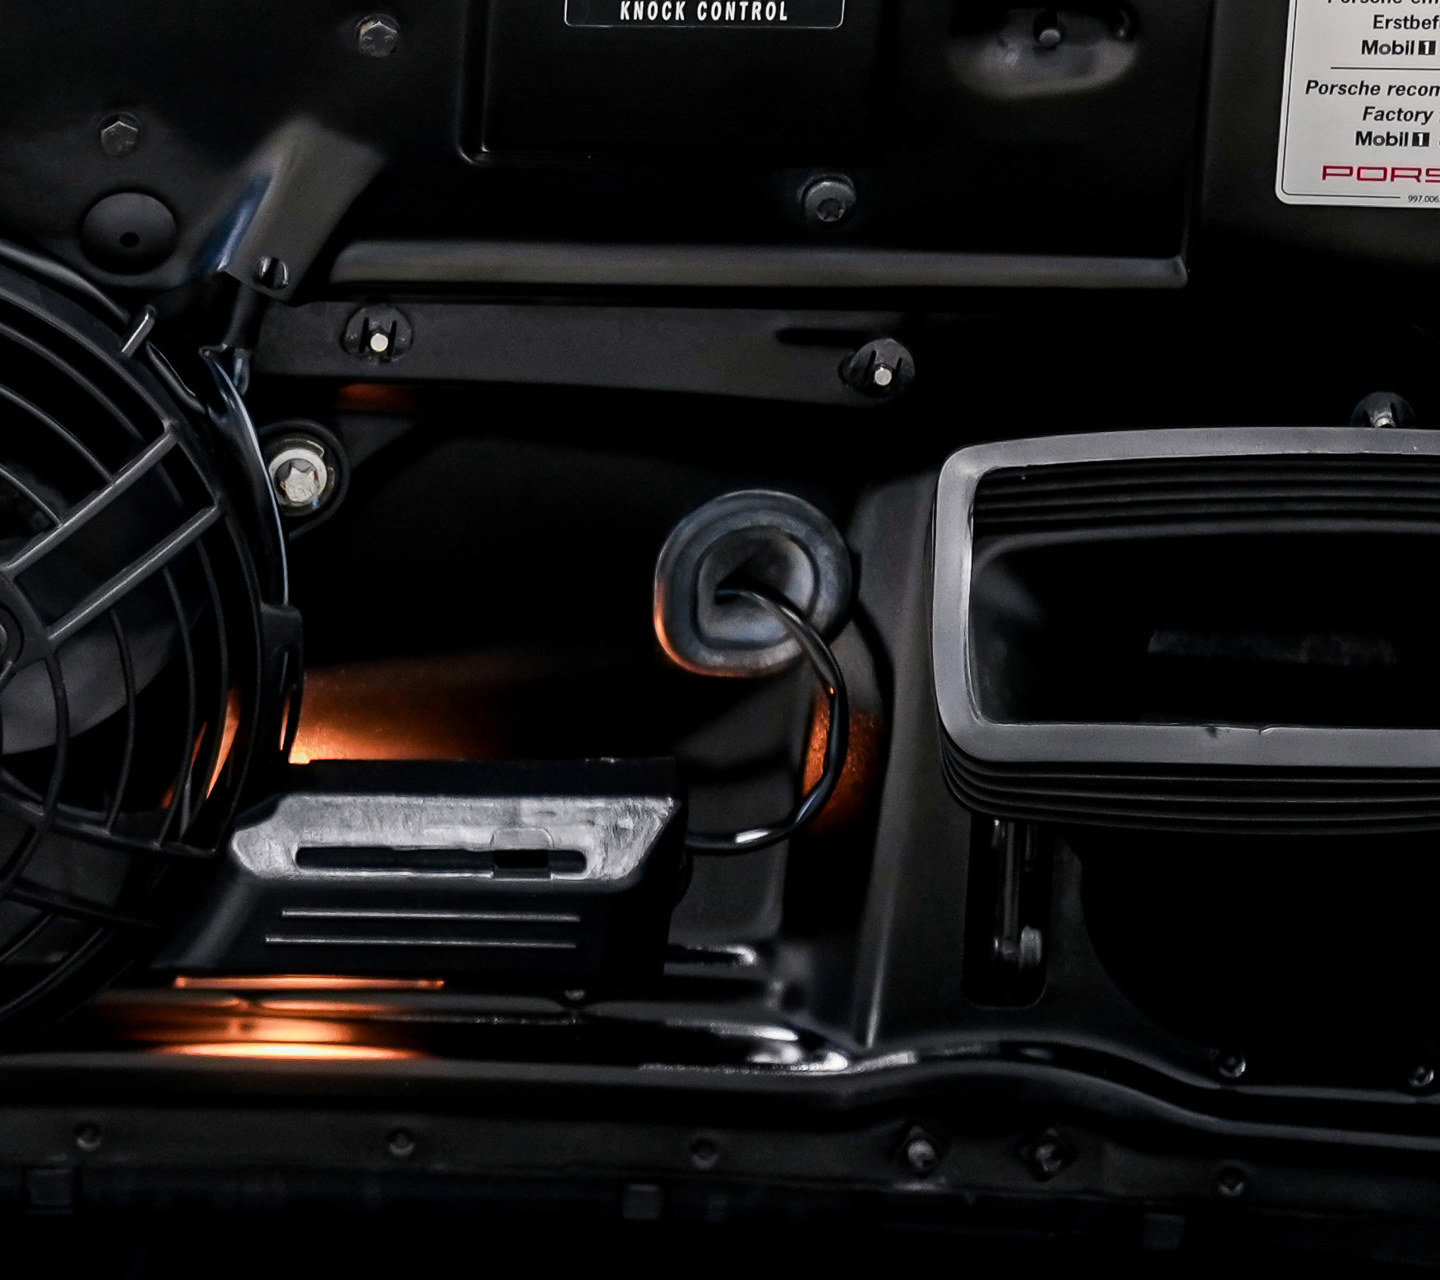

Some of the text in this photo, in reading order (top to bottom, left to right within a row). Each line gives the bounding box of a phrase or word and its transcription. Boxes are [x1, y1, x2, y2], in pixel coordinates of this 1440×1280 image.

[620, 1, 788, 21] KNOCK CONTROL
[1305, 80, 1380, 96] Porsche
[1362, 106, 1434, 125] Factory
